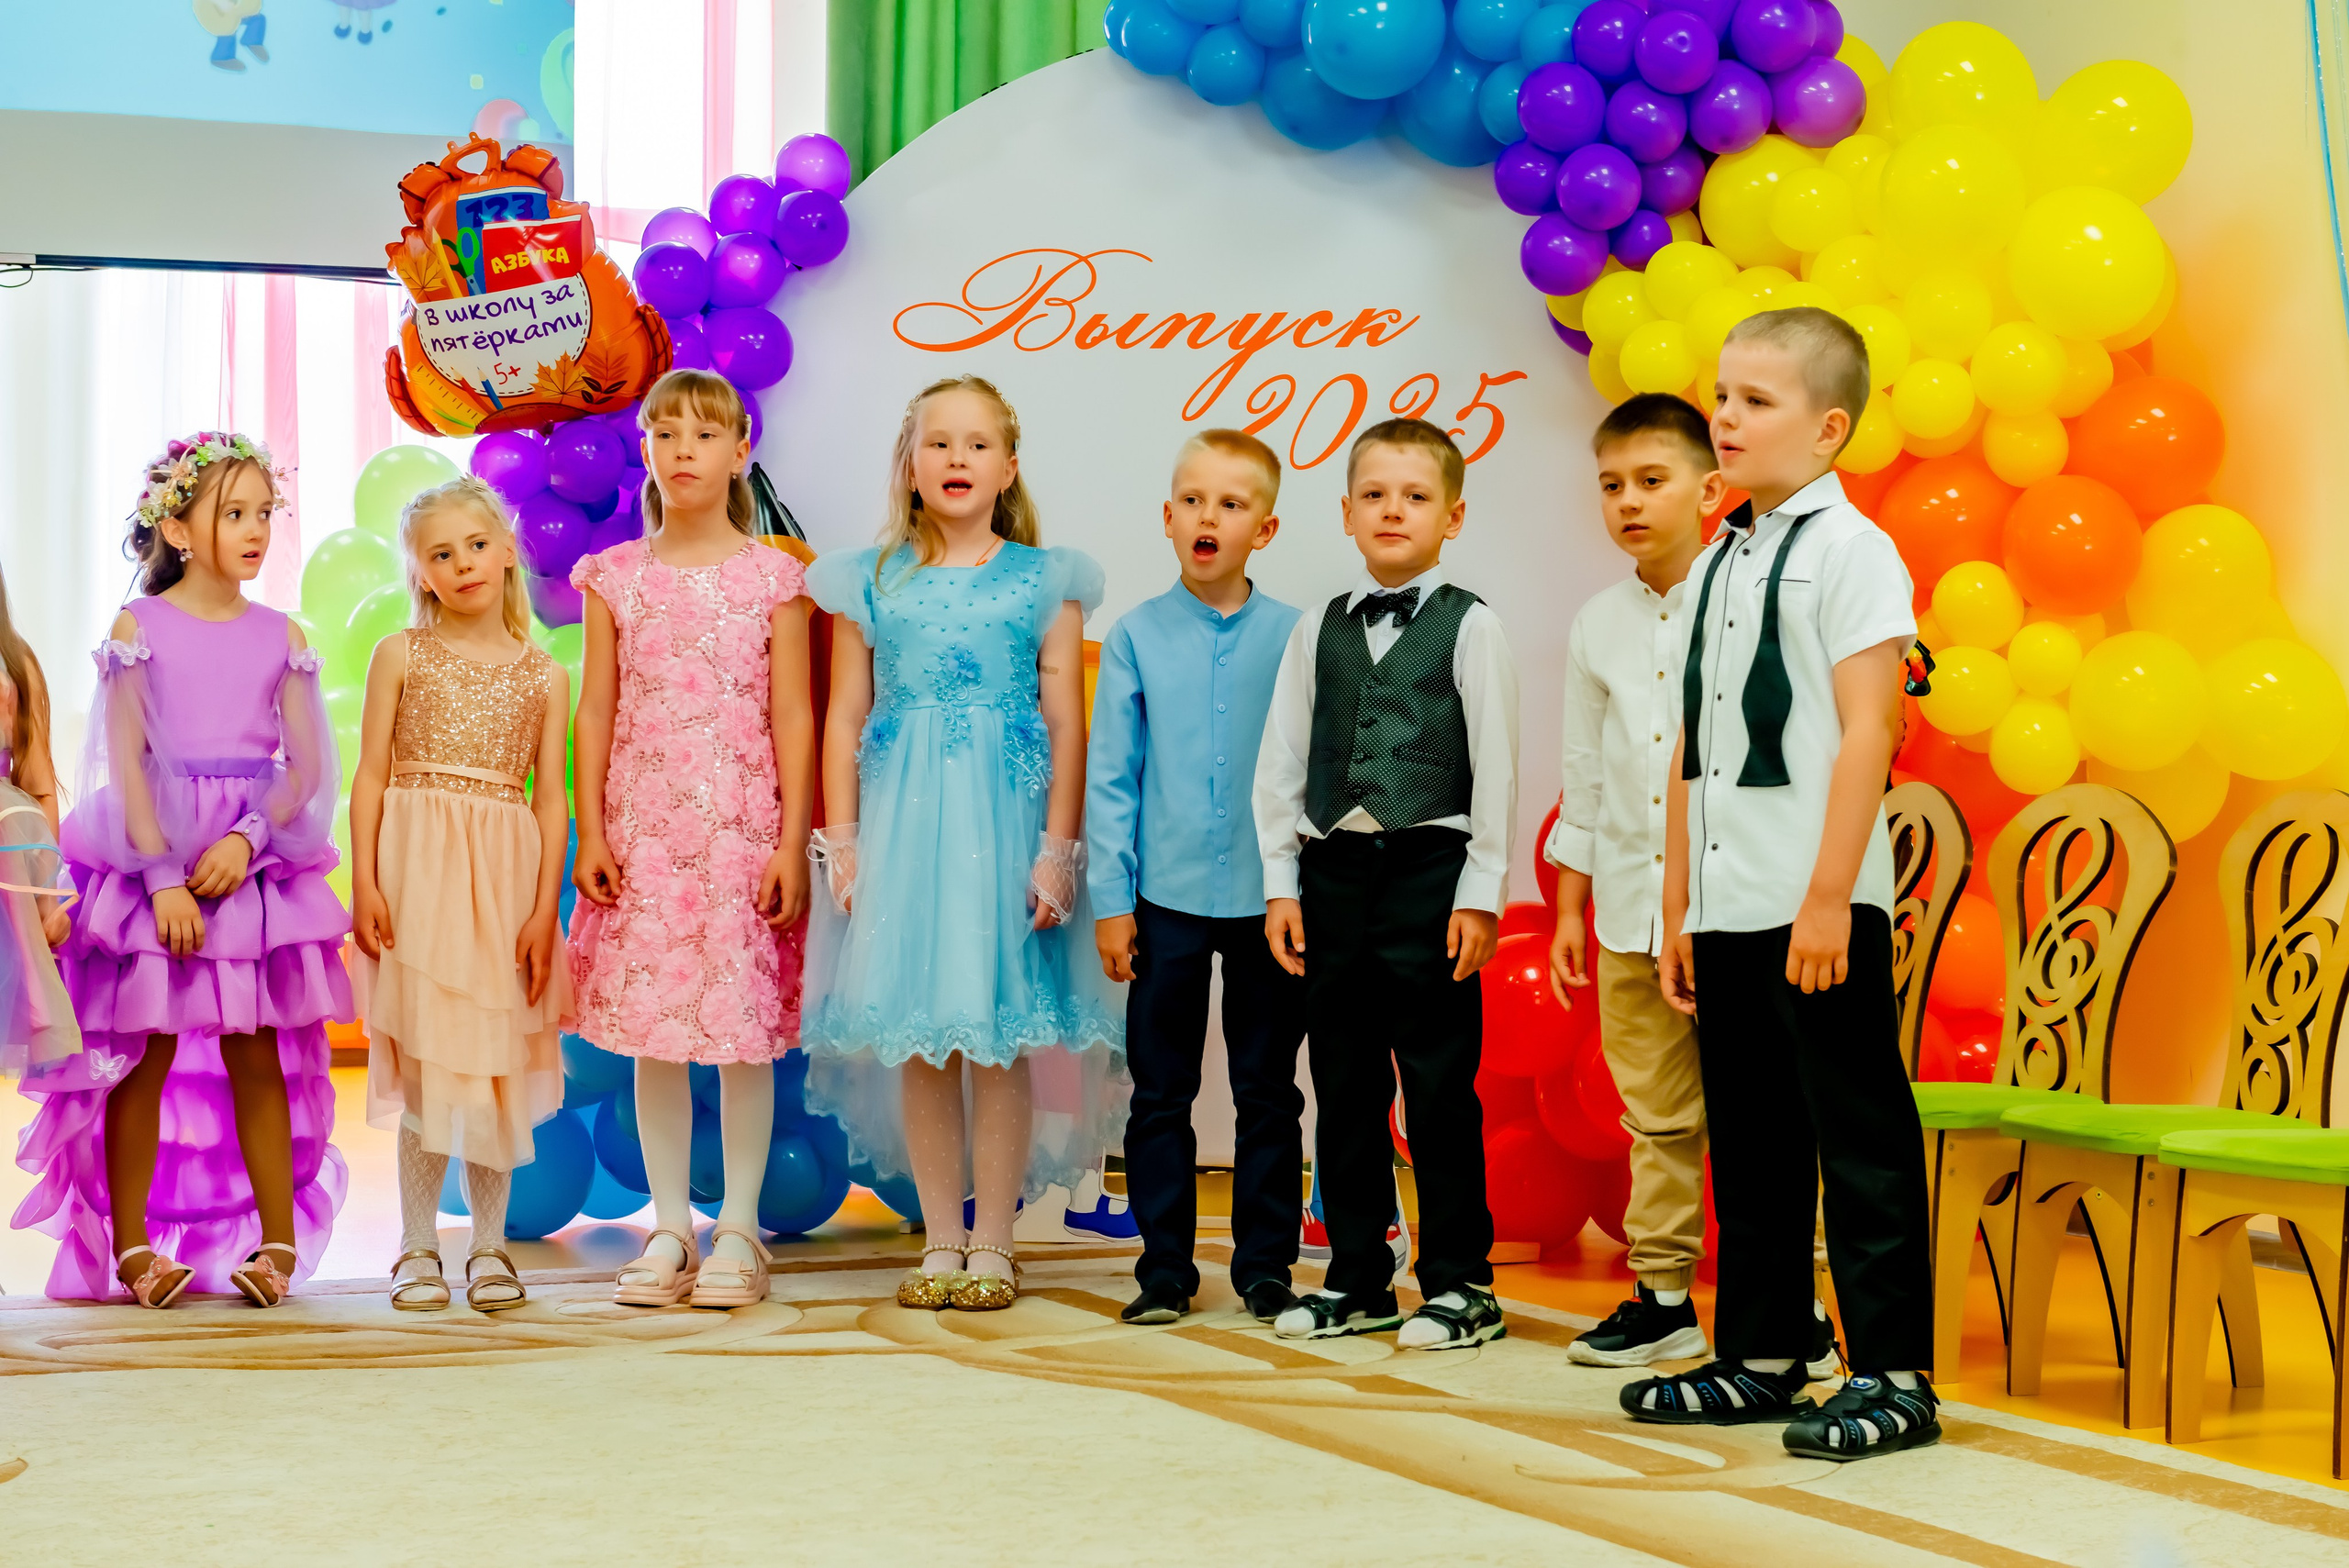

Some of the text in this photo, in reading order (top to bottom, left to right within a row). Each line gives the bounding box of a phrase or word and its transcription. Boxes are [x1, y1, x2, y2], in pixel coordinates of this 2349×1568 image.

[465, 194, 534, 228] 123
[490, 246, 570, 274] АЗБУКА
[424, 284, 574, 326] В школу за
[430, 311, 584, 357] пятёрками
[893, 248, 1420, 422] Выпуск
[493, 361, 521, 385] 5+
